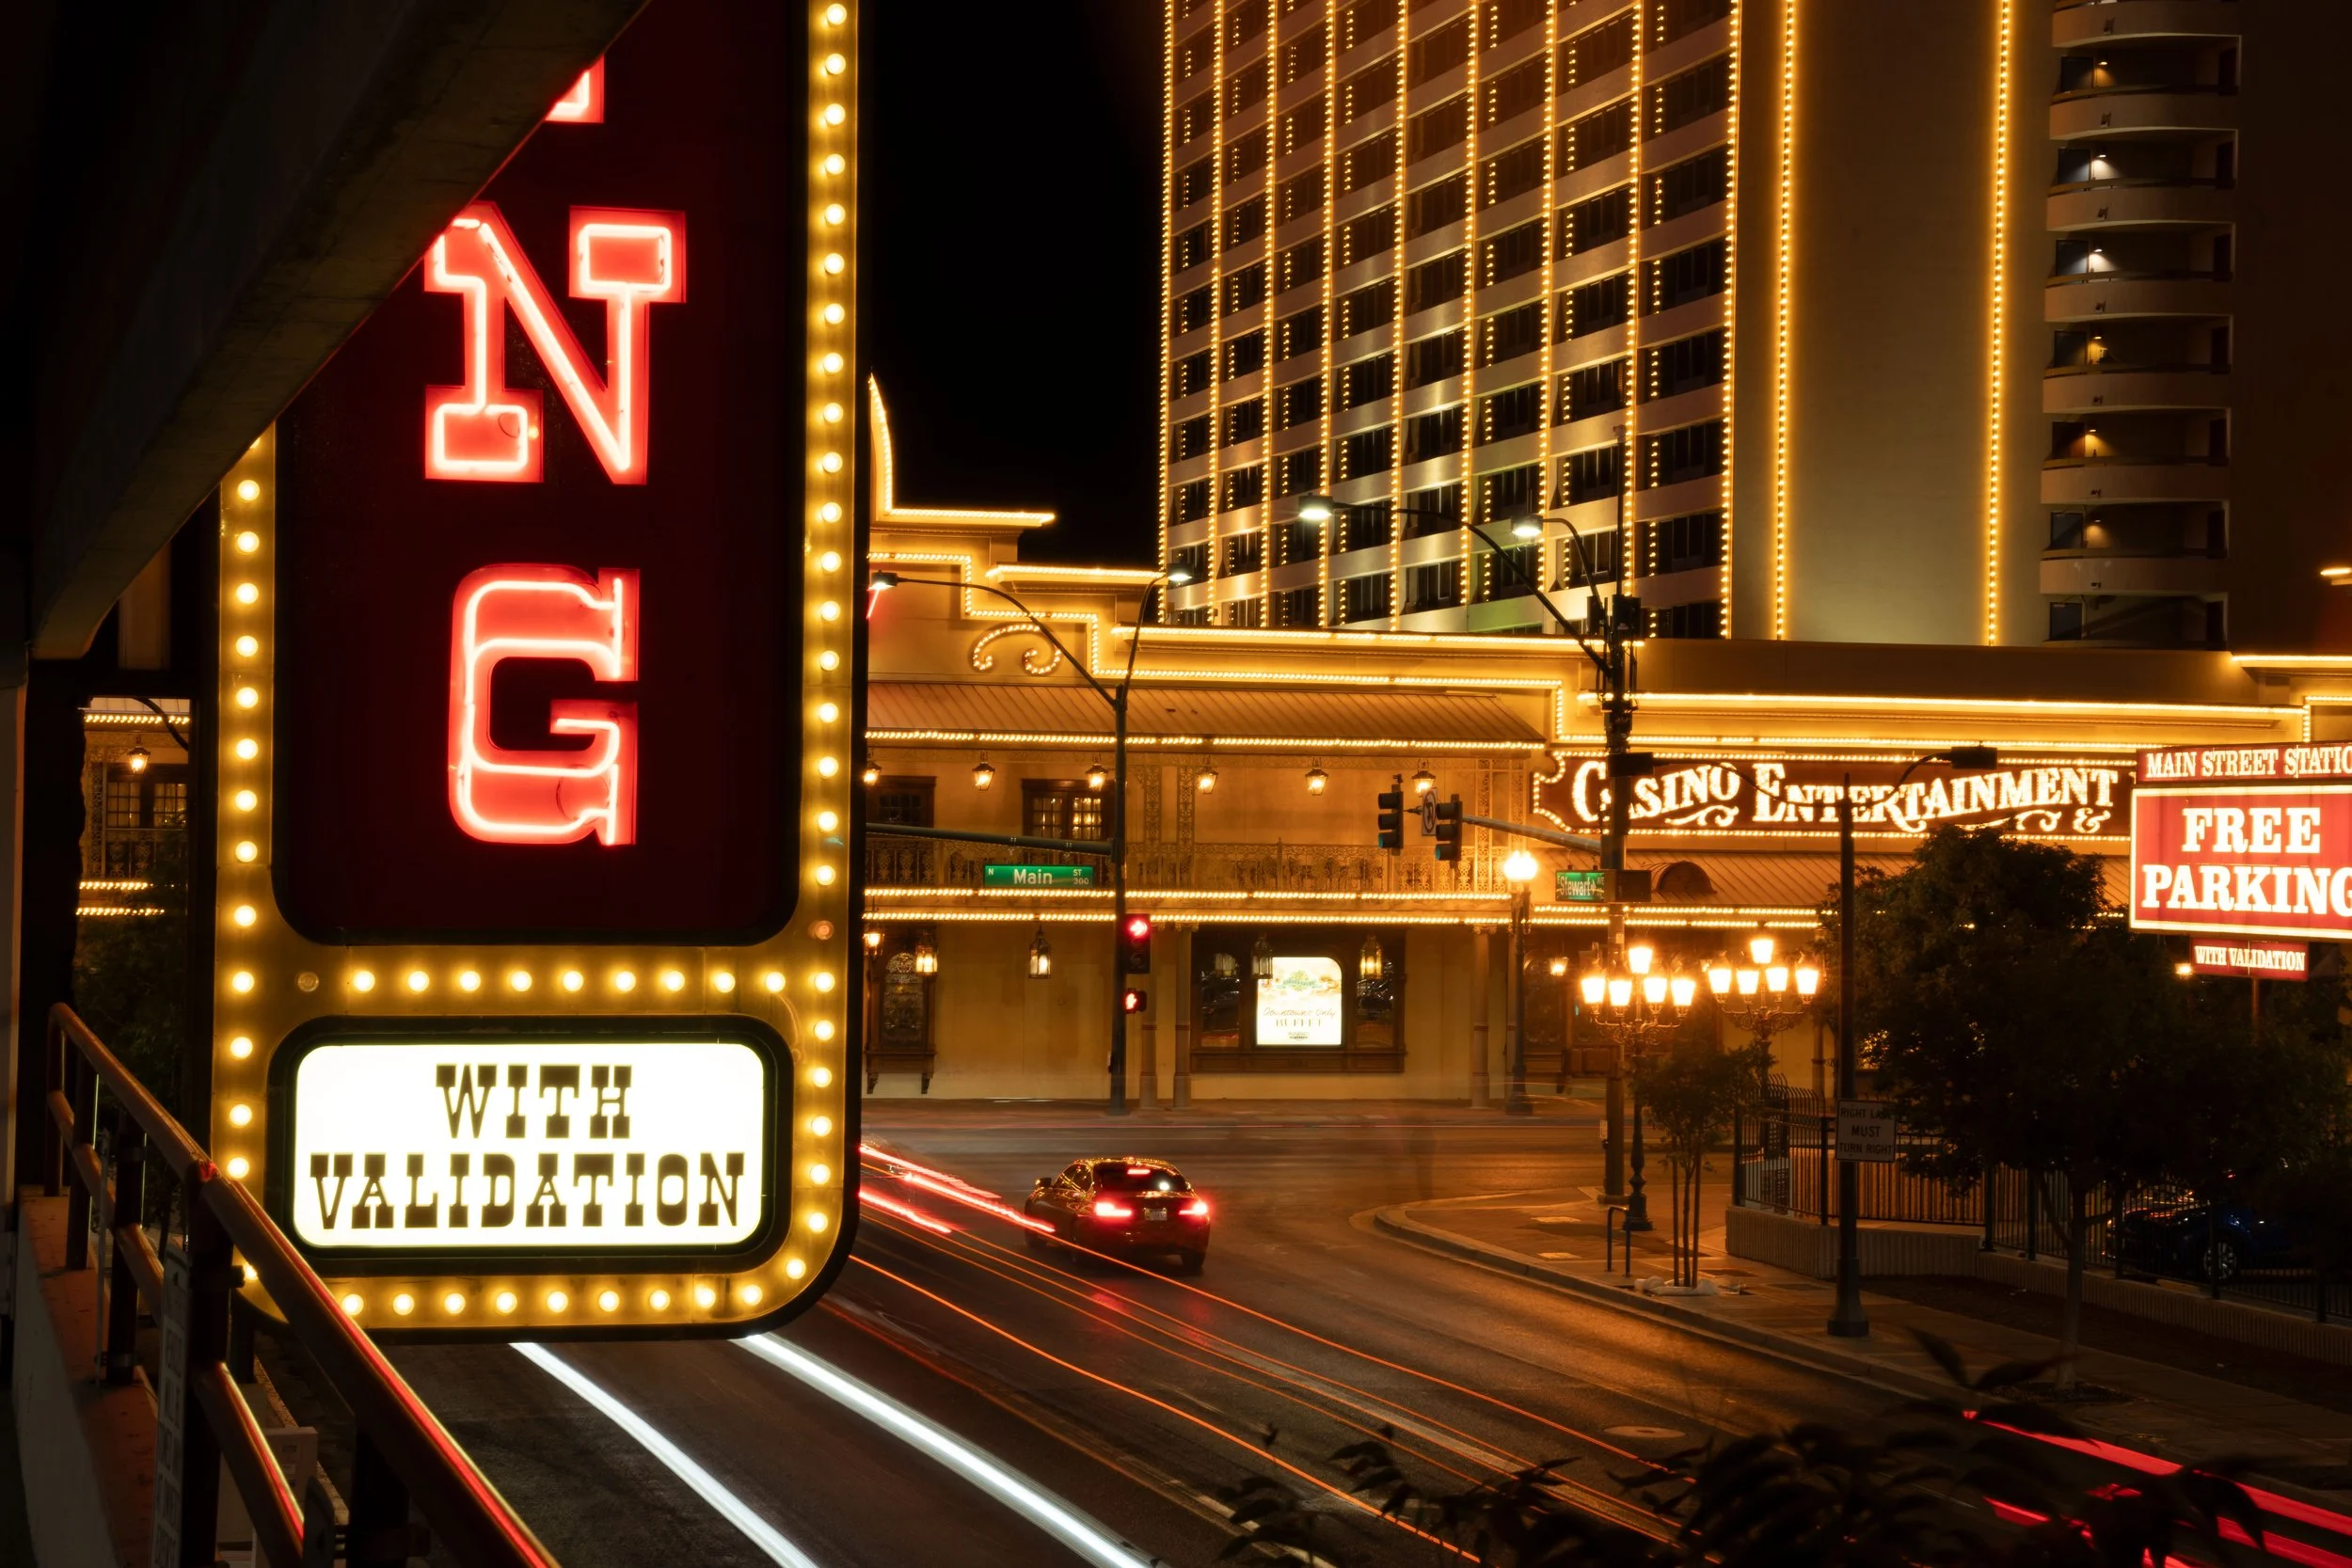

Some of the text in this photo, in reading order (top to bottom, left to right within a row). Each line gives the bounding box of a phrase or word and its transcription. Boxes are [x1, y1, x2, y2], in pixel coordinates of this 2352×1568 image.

[424, 52, 686, 847] NG
[2145, 752, 2198, 779] MAIN
[2201, 749, 2280, 778] STREET
[2182, 807, 2321, 853] FREE
[988, 867, 1083, 885] N Main ST
[1073, 877, 1089, 885] 300
[1561, 876, 1590, 896] Stewart
[2141, 863, 2352, 917] PARKING
[2194, 945, 2306, 972] WITH VALIDATION
[435, 1064, 633, 1139] WITH
[1840, 1107, 1867, 1118] RIGHT
[1851, 1124, 1882, 1138] MUST
[1839, 1142, 1894, 1156] TURN RIGHT
[310, 1152, 746, 1229] VALIDATION
